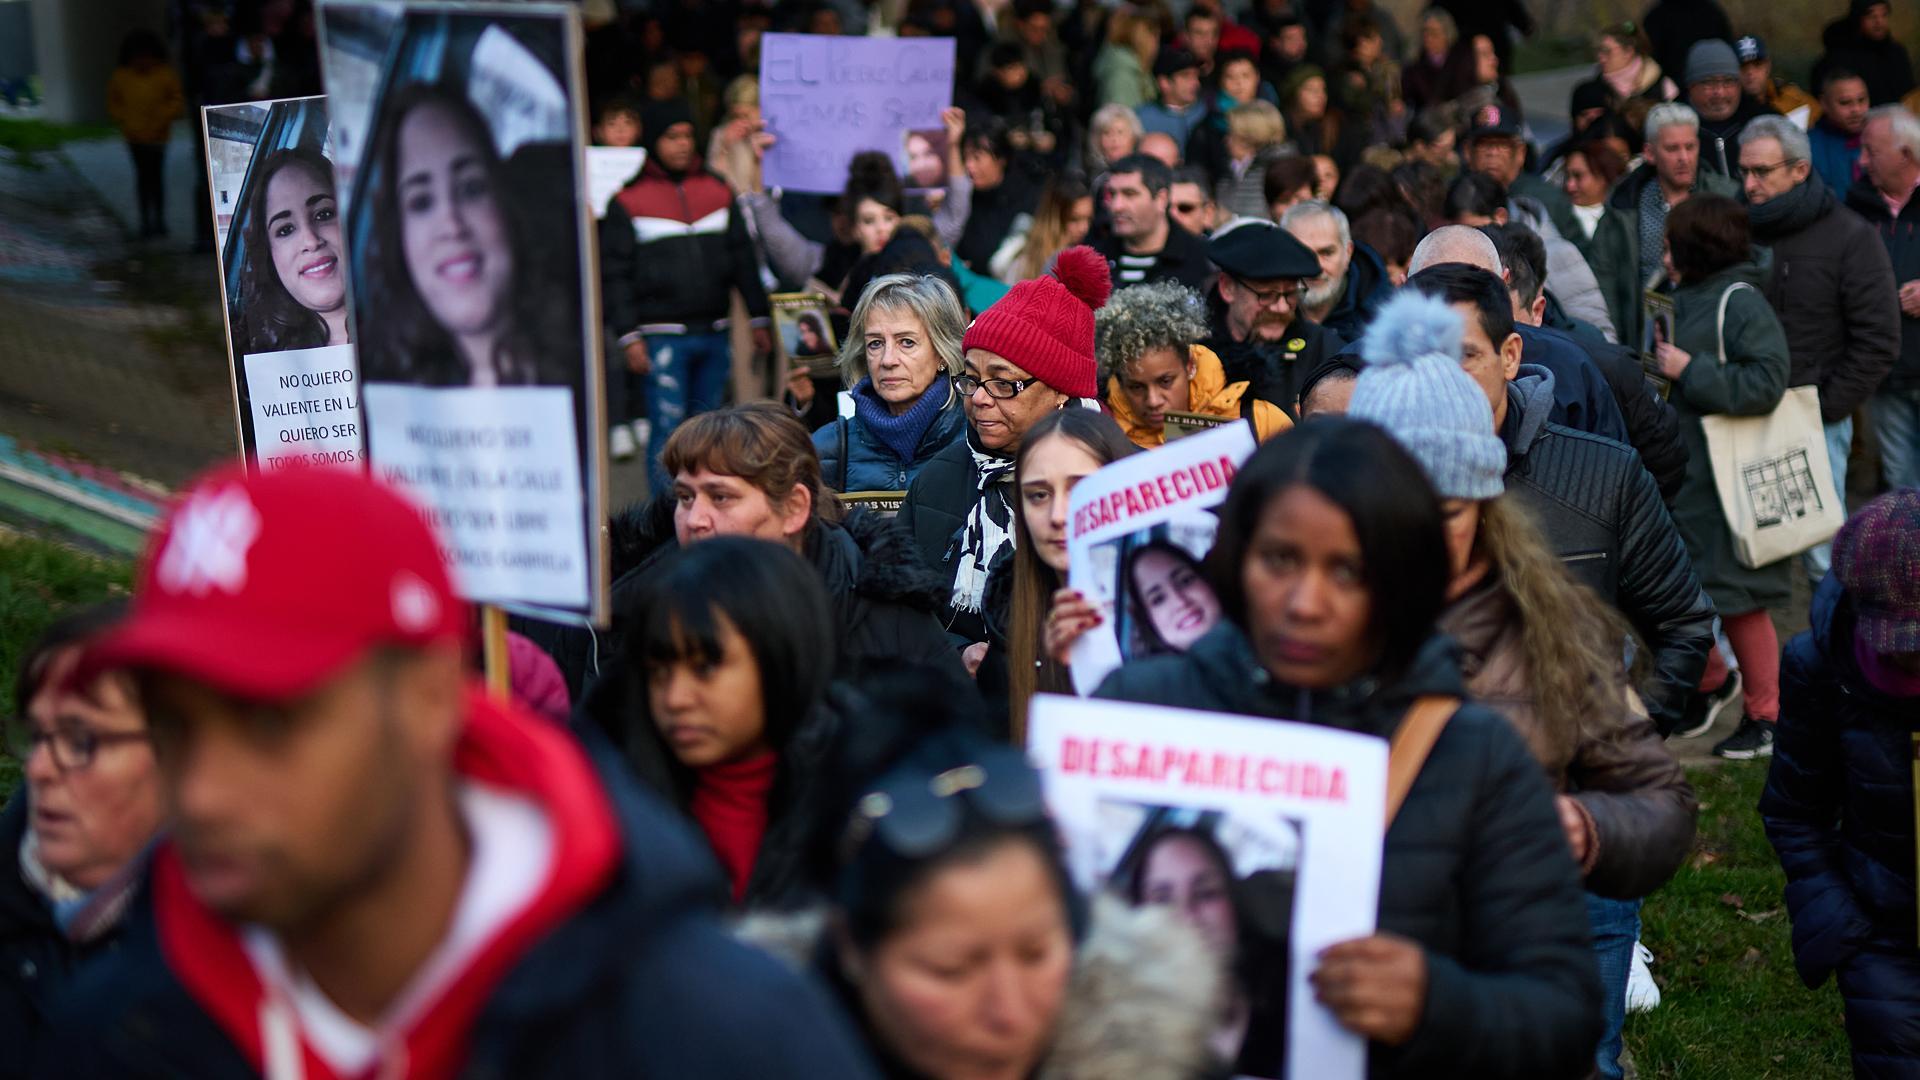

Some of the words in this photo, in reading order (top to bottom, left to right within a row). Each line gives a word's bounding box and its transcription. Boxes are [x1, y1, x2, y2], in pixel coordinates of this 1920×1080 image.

[279, 374, 299, 389] NO
[301, 369, 353, 388] QUIERO
[262, 400, 322, 417] VALIENTE
[324, 398, 343, 412] EN
[1167, 415, 1180, 423] LE
[279, 426, 329, 444] QUIERO
[331, 423, 357, 438] SER
[311, 449, 355, 467] SOMOS
[1074, 455, 1237, 539] DESAPARECIDA
[1061, 737, 1348, 804] DESAPARECIDA
